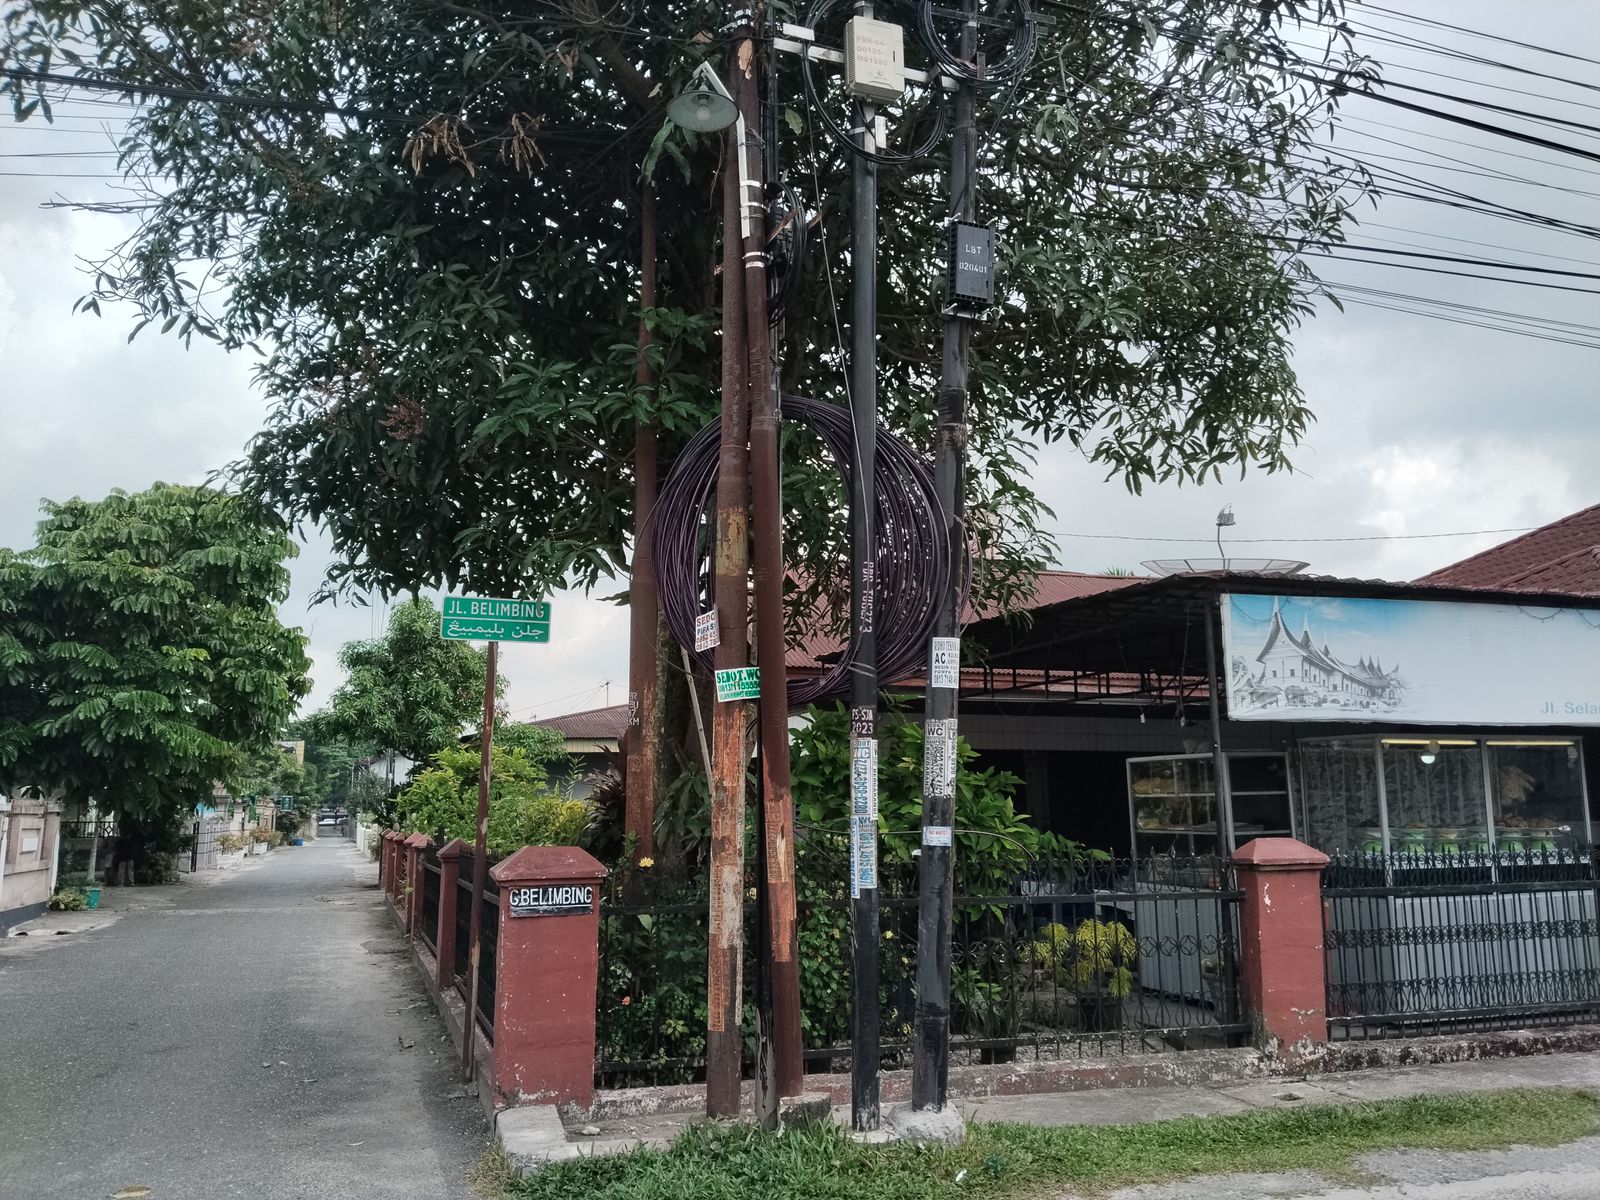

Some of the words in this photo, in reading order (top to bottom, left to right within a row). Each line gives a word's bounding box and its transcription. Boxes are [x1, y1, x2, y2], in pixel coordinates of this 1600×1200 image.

[449, 600, 467, 615] JL.
[471, 602, 545, 619] BELIMBING
[852, 721, 873, 734] 2023
[927, 727, 943, 736] WC
